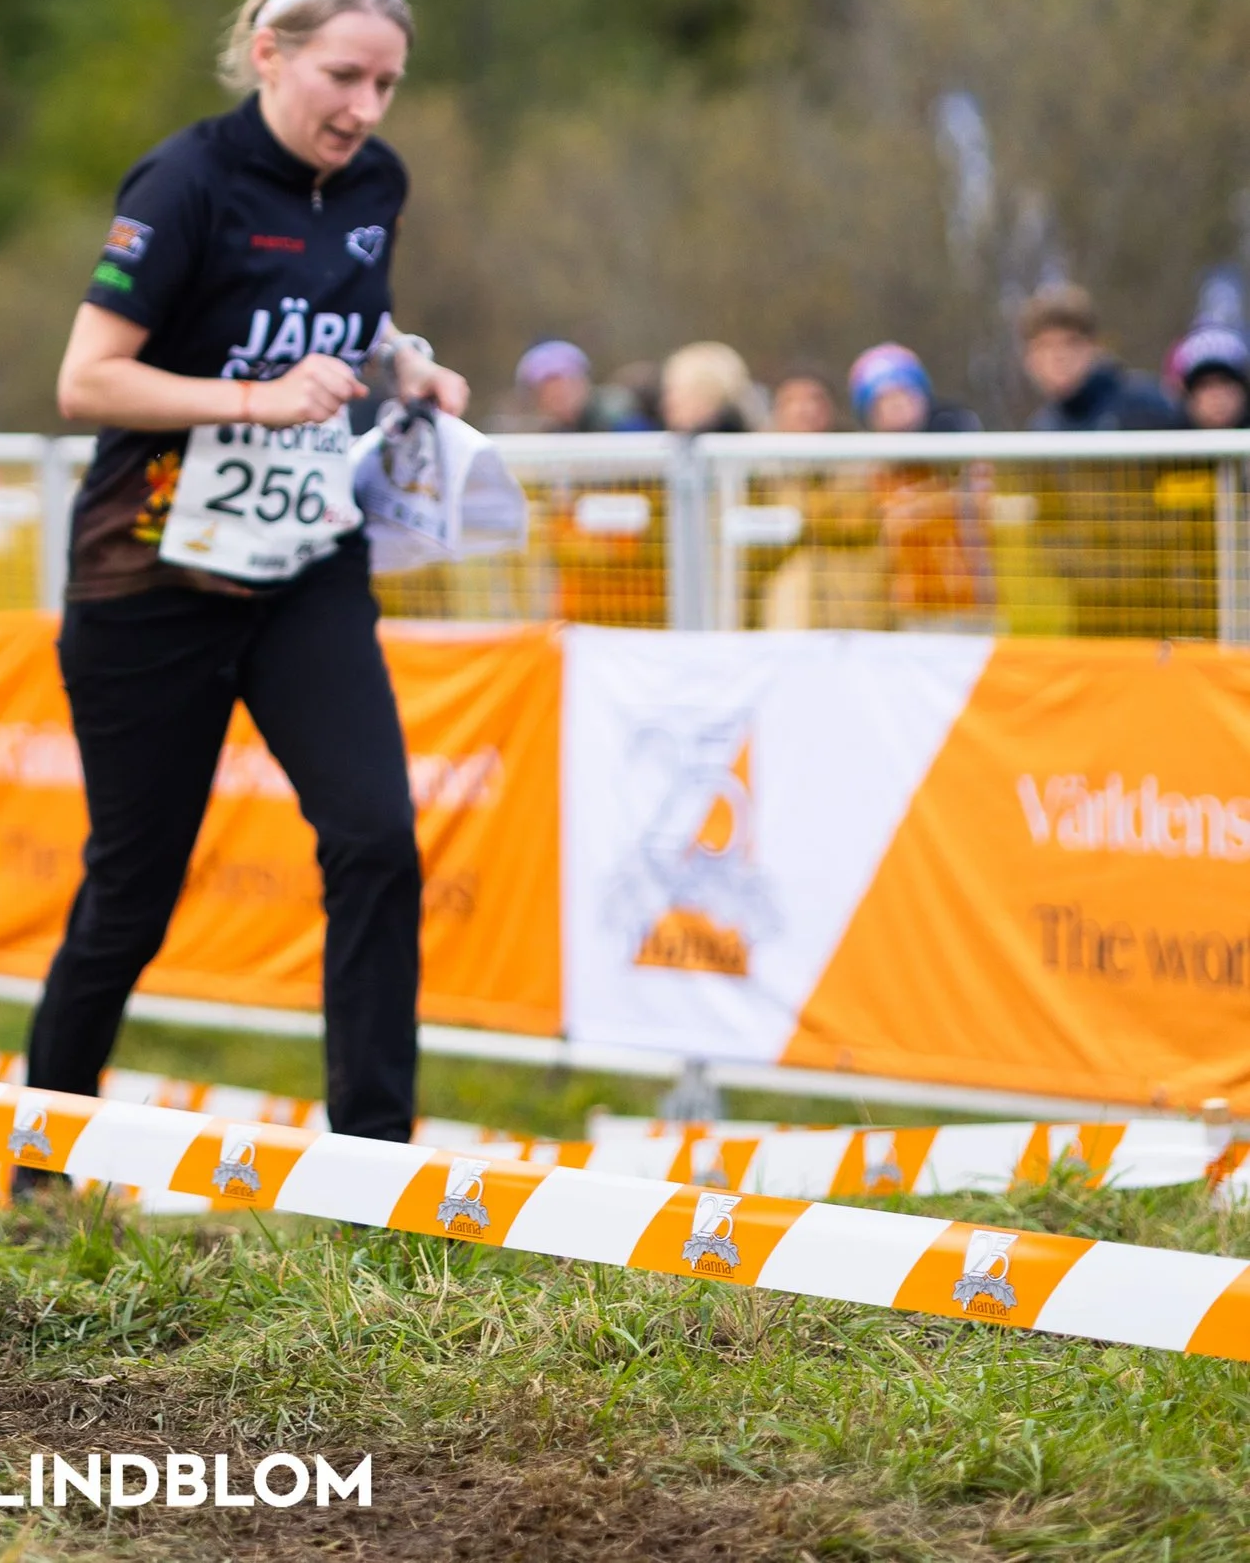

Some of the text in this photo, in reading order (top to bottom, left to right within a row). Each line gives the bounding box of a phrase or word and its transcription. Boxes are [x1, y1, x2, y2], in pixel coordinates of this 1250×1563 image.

[204, 458, 326, 525] 256
[1031, 902, 1250, 994] The wor
